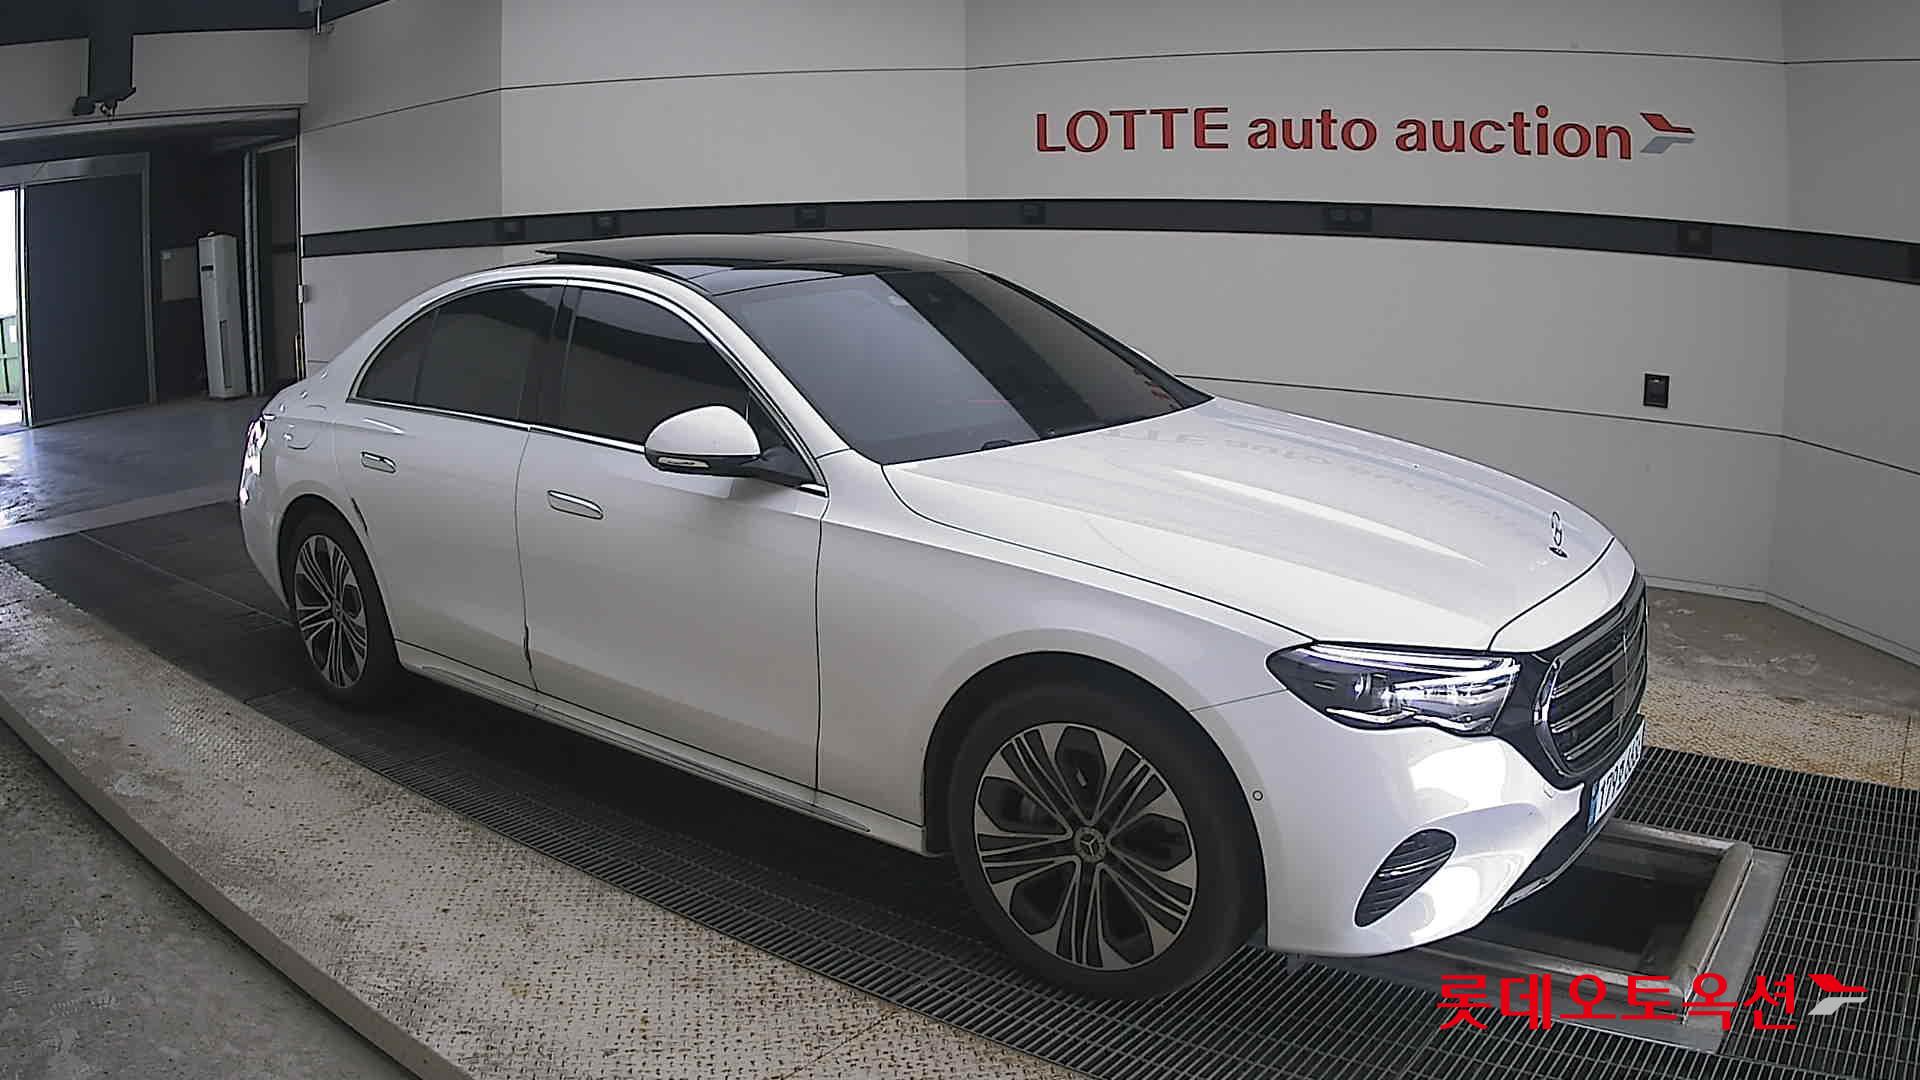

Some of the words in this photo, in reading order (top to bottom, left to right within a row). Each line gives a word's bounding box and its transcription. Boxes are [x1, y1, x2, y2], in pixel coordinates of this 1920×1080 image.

[1036, 107, 1229, 153] LOTTE
[1247, 109, 1378, 152] auto
[1395, 105, 1632, 160] auction
